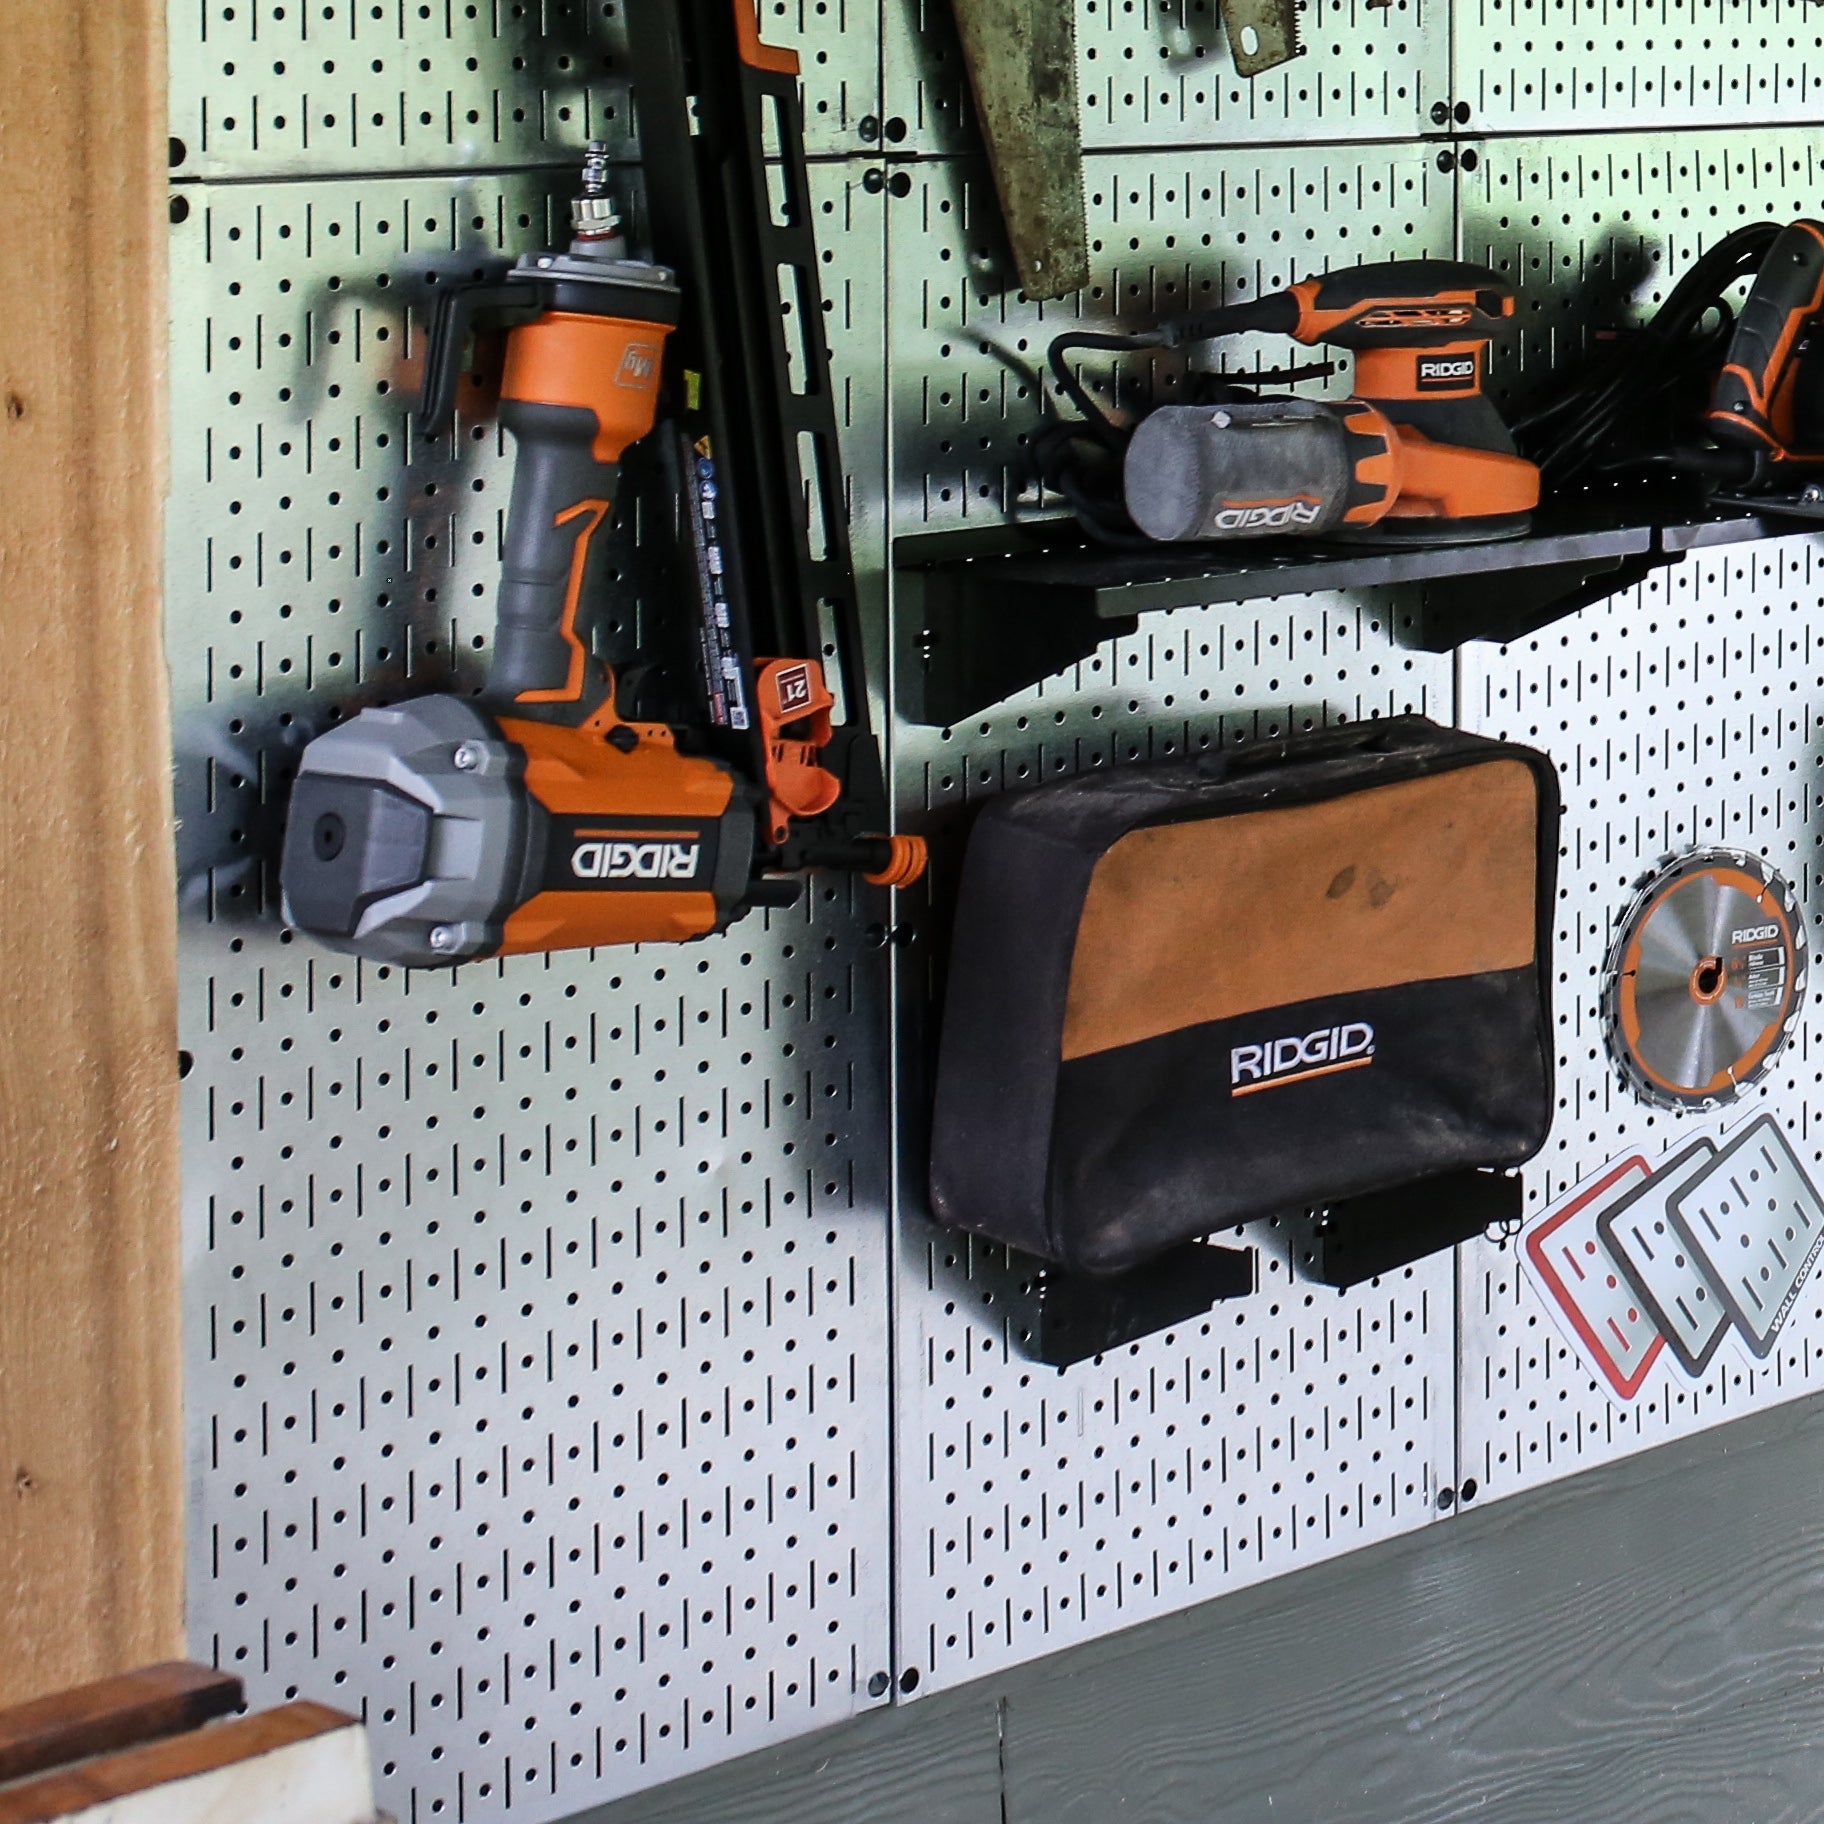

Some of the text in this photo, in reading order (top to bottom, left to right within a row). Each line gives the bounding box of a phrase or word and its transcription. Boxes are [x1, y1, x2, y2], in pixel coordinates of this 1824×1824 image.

[1421, 360, 1474, 377] RIDGID
[1214, 501, 1321, 529] RIDGID
[570, 843, 700, 879] RIDGID
[1731, 924, 1780, 945] RIDGID
[1230, 1022, 1375, 1084] RIDGID
[1770, 1291, 1797, 1332] WALL
